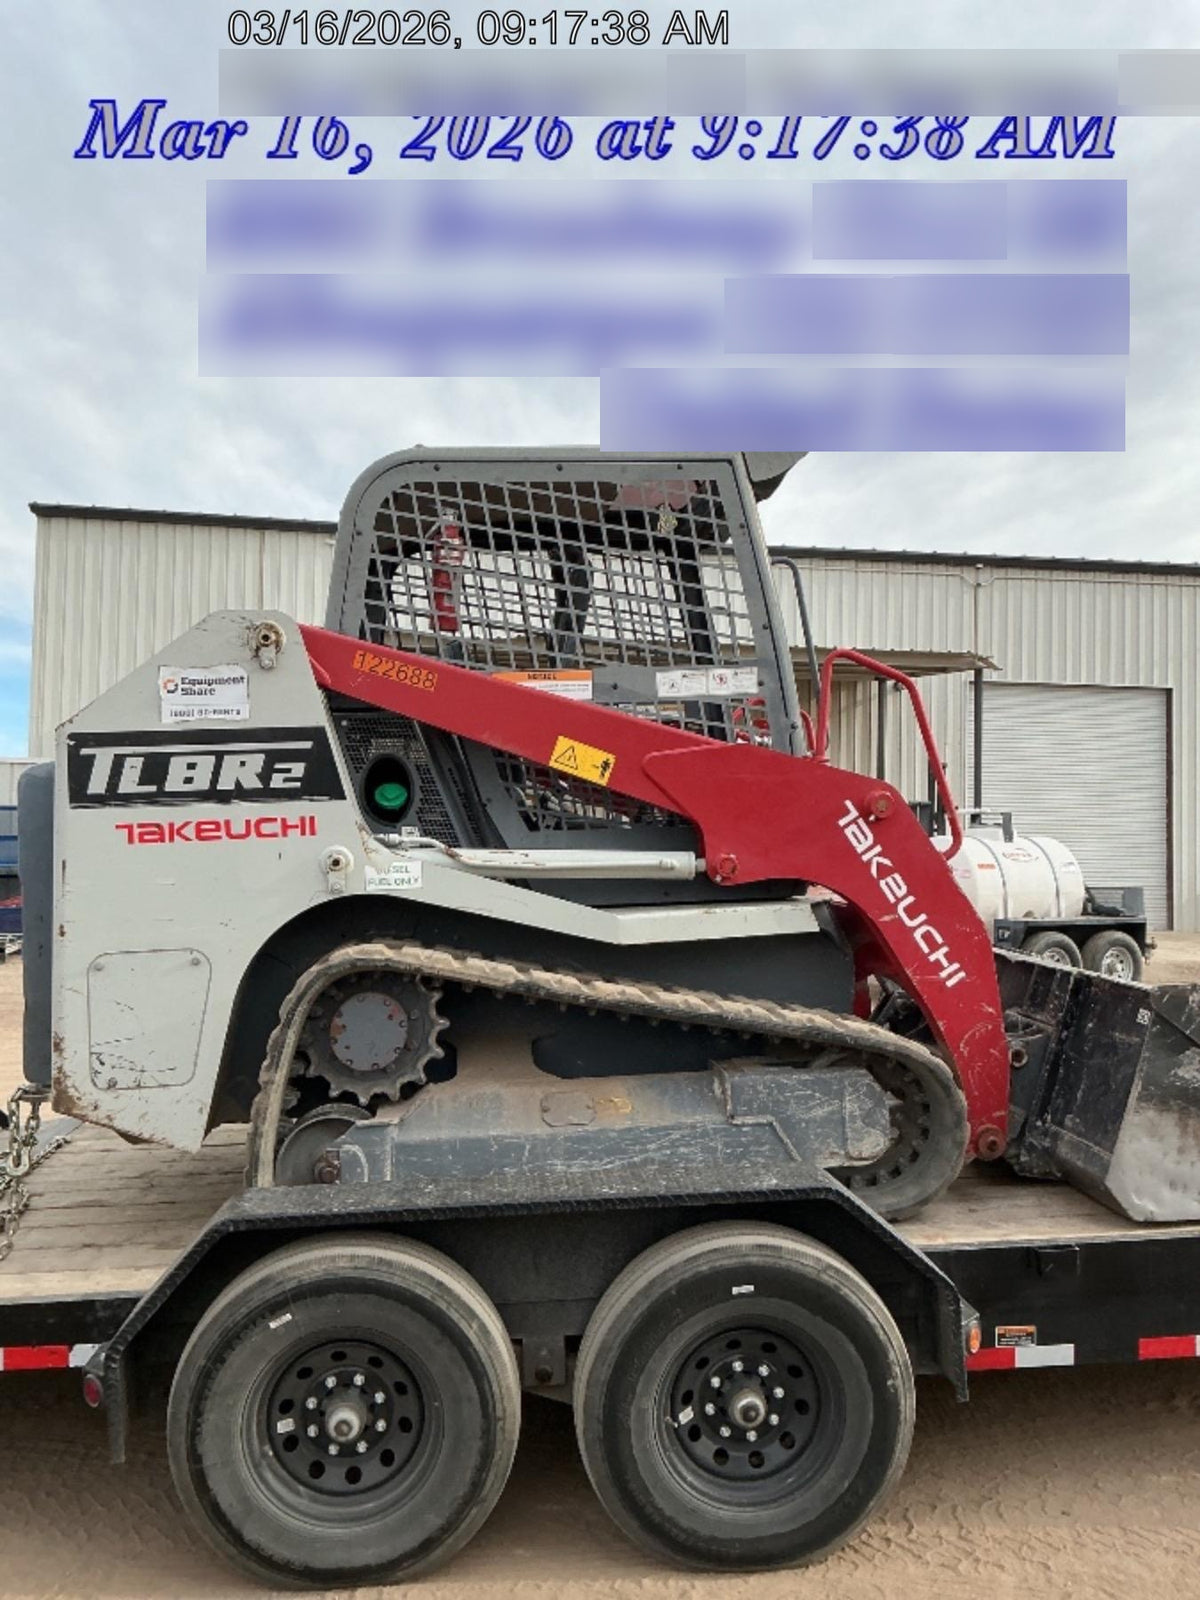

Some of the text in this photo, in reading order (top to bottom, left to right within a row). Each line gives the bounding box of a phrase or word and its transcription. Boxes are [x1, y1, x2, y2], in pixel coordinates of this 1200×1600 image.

[357, 652, 435, 688] 122688
[181, 677, 245, 686] Equipment
[181, 688, 216, 696] Share
[79, 741, 314, 795] TL8R2
